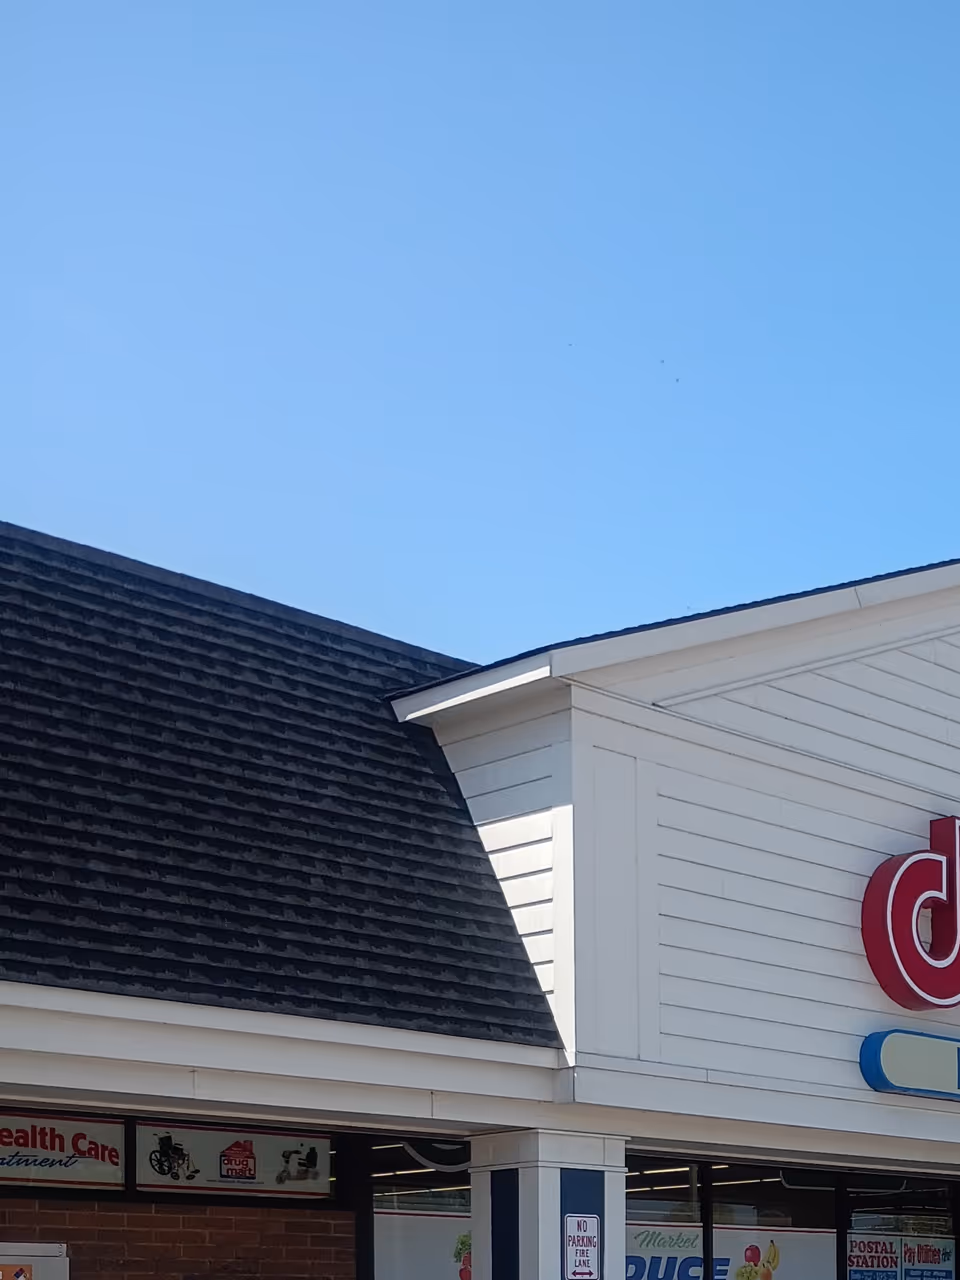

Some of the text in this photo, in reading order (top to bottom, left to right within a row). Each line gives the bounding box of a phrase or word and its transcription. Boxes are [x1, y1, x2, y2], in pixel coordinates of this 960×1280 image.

[71, 1133, 120, 1167] Care
[223, 1157, 249, 1169] drug
[577, 1220, 588, 1233] NO
[568, 1235, 597, 1248] PARKING
[634, 1230, 699, 1249] Market
[575, 1249, 590, 1258] FIRE
[850, 1240, 897, 1255] POSTAL
[574, 1259, 591, 1268] LANE
[848, 1254, 899, 1269] STATION
